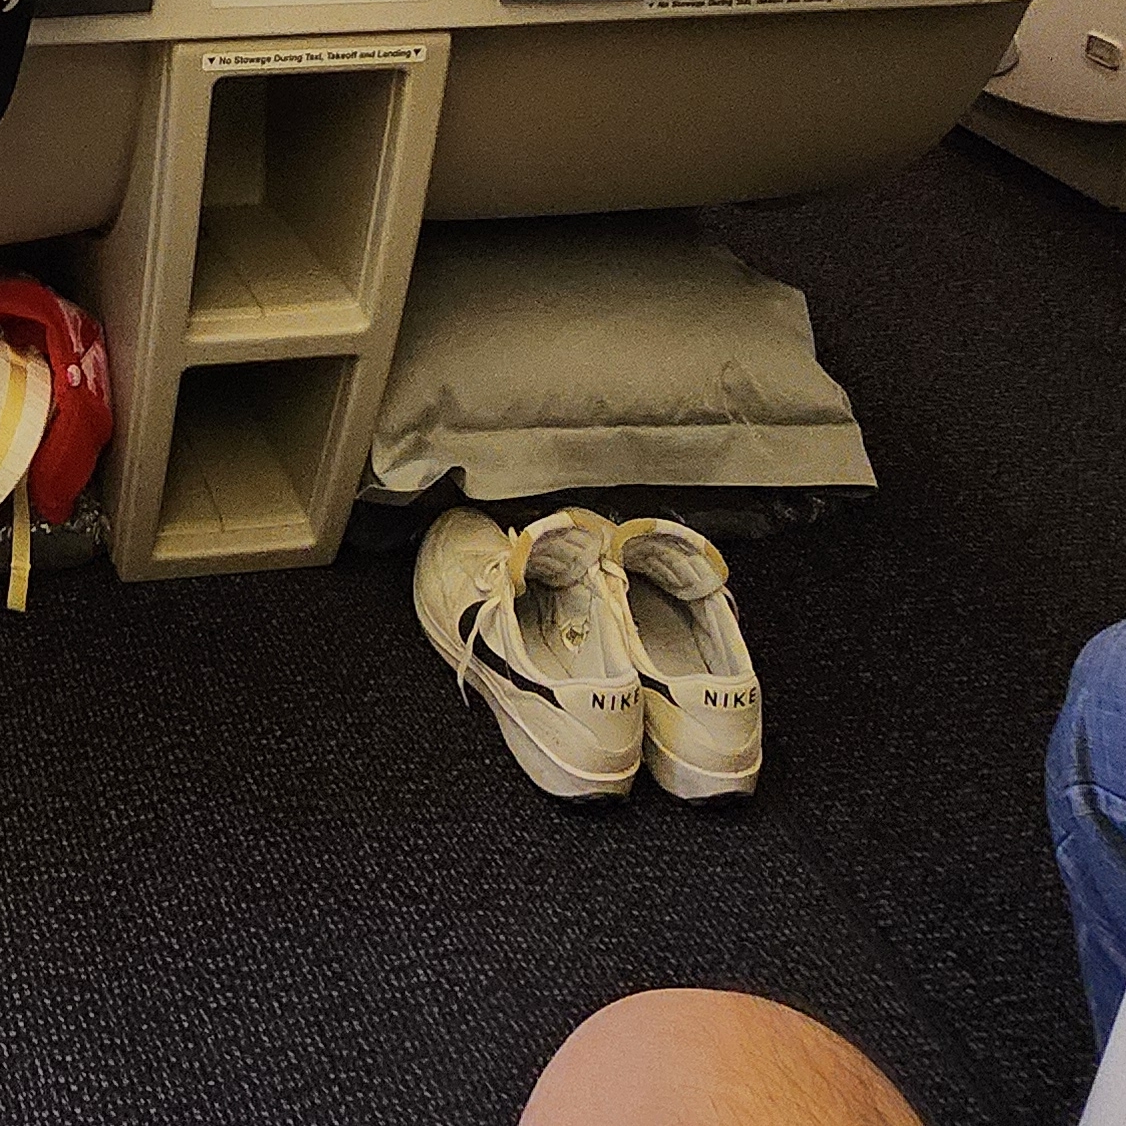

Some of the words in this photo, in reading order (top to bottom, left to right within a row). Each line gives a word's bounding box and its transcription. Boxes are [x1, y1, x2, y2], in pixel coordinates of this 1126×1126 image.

[219, 56, 231, 65] No
[234, 56, 271, 65] Stowage
[274, 54, 303, 63] During
[327, 51, 357, 60] Takeoff
[378, 50, 412, 59] Landing
[592, 687, 639, 710] NIKE
[704, 687, 756, 708] NIKE
